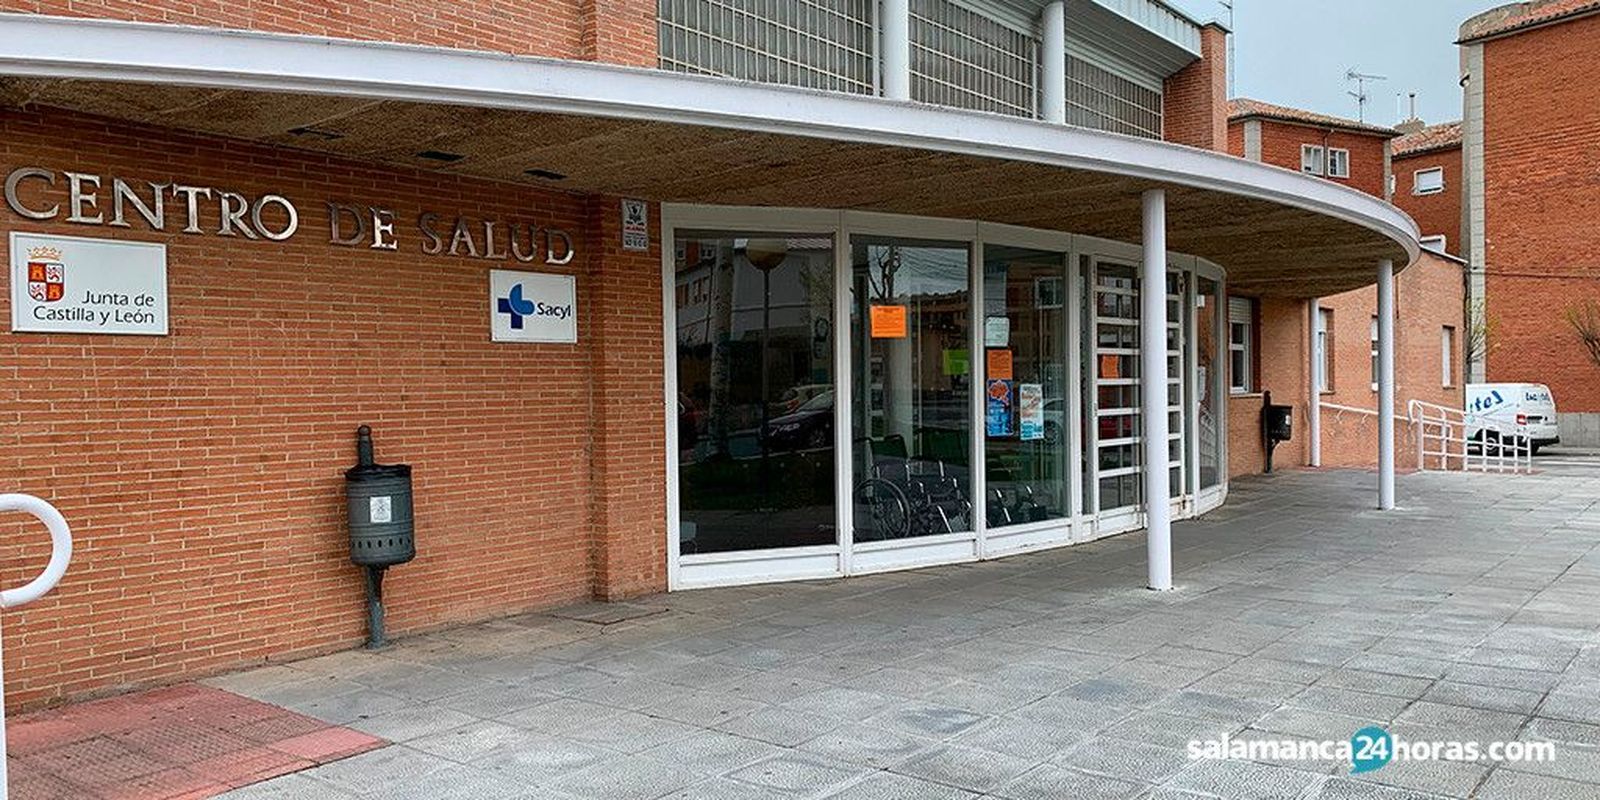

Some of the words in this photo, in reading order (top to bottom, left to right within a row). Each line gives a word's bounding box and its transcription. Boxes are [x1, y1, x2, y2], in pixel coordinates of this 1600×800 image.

[4, 167, 298, 240] CENTRO
[327, 201, 398, 250] DE
[419, 211, 575, 265] SALUD
[82, 290, 128, 306] Junta
[134, 293, 154, 307] de
[33, 305, 94, 321] Castilla
[100, 310, 111, 325] y
[115, 307, 155, 324] León
[537, 303, 571, 319] Sacyl
